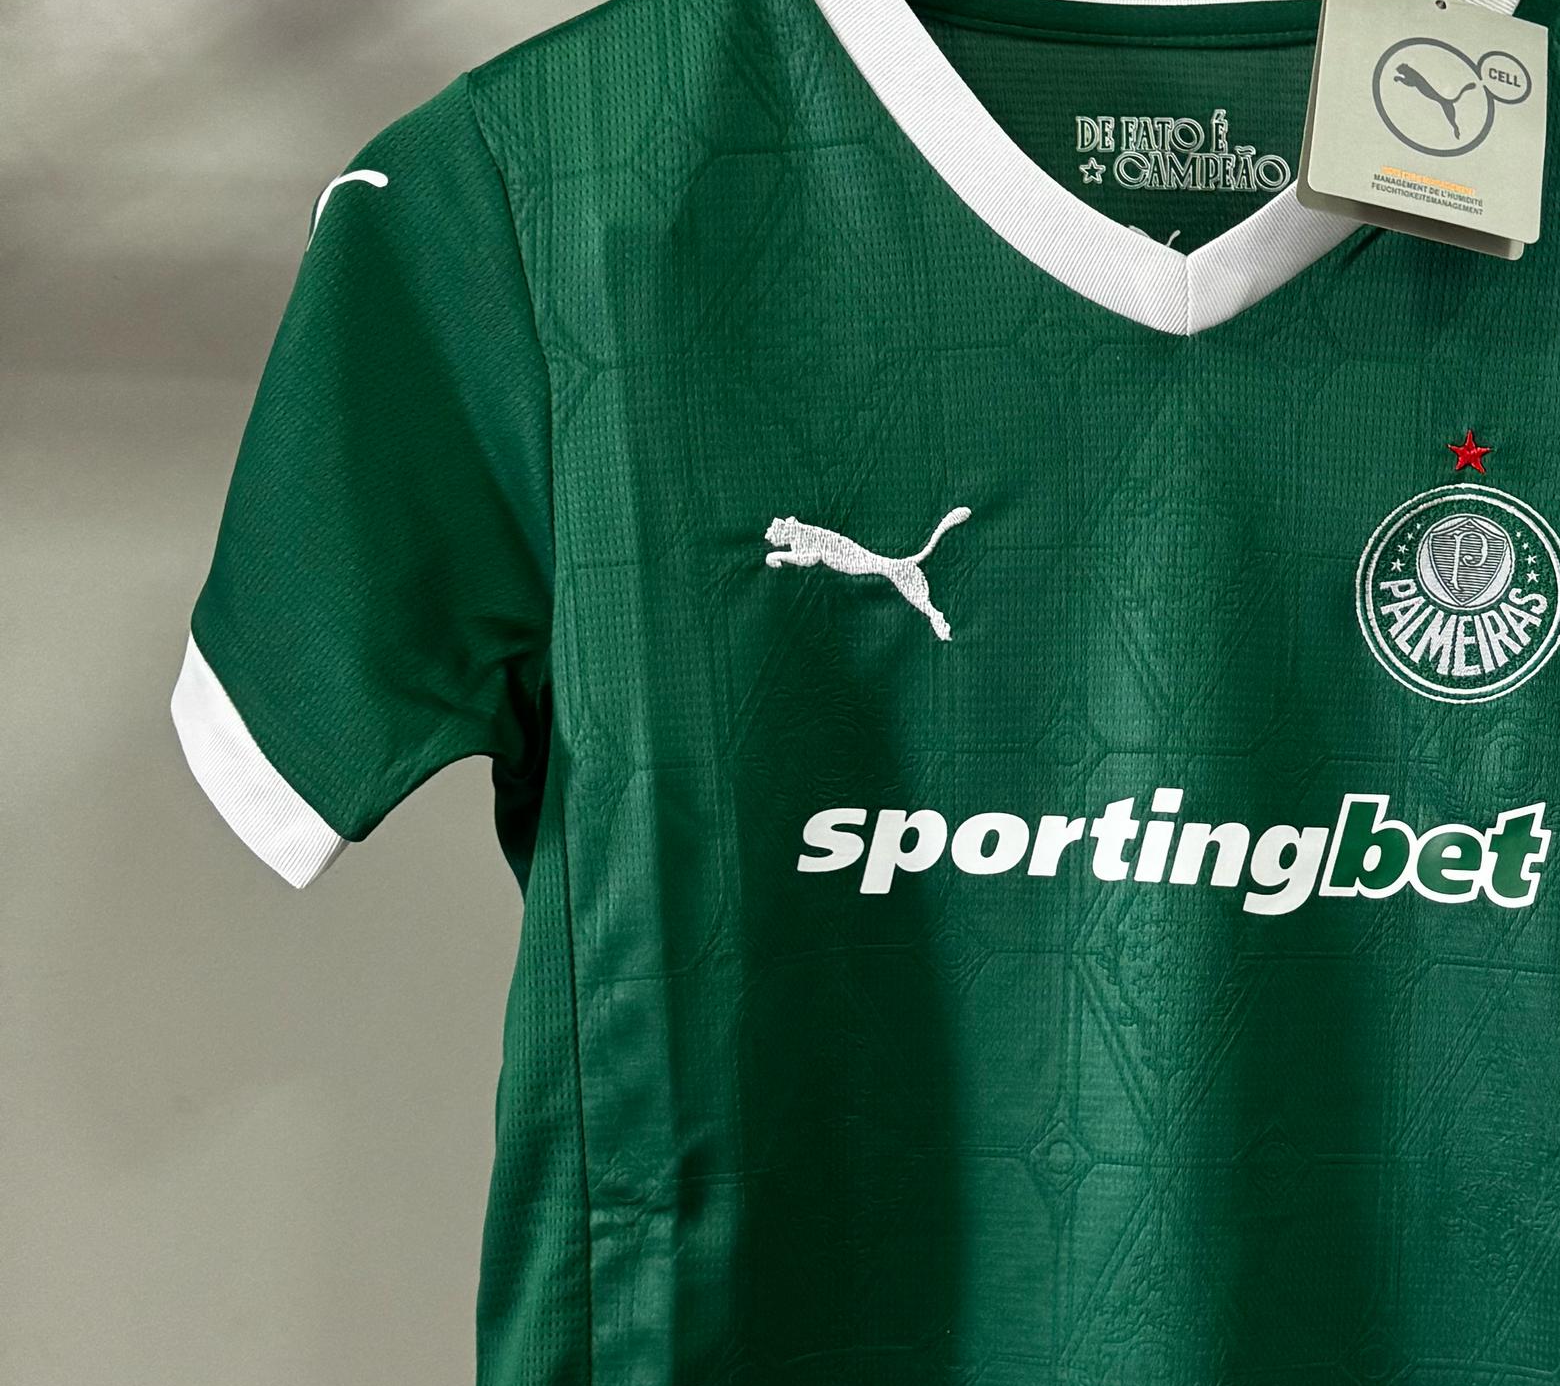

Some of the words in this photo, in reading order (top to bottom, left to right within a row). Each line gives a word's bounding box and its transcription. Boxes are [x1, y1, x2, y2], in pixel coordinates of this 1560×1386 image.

[1488, 67, 1521, 88] CELL
[1075, 115, 1115, 153] DE
[1120, 116, 1205, 154] FATO
[1211, 108, 1229, 154] É
[1113, 145, 1292, 193] CAMPEÃO
[1373, 173, 1428, 194] MANAGEMENT
[1429, 186, 1440, 196] DE
[1379, 577, 1549, 677] PALMEIRAS
[797, 787, 1549, 917] sportingbet
